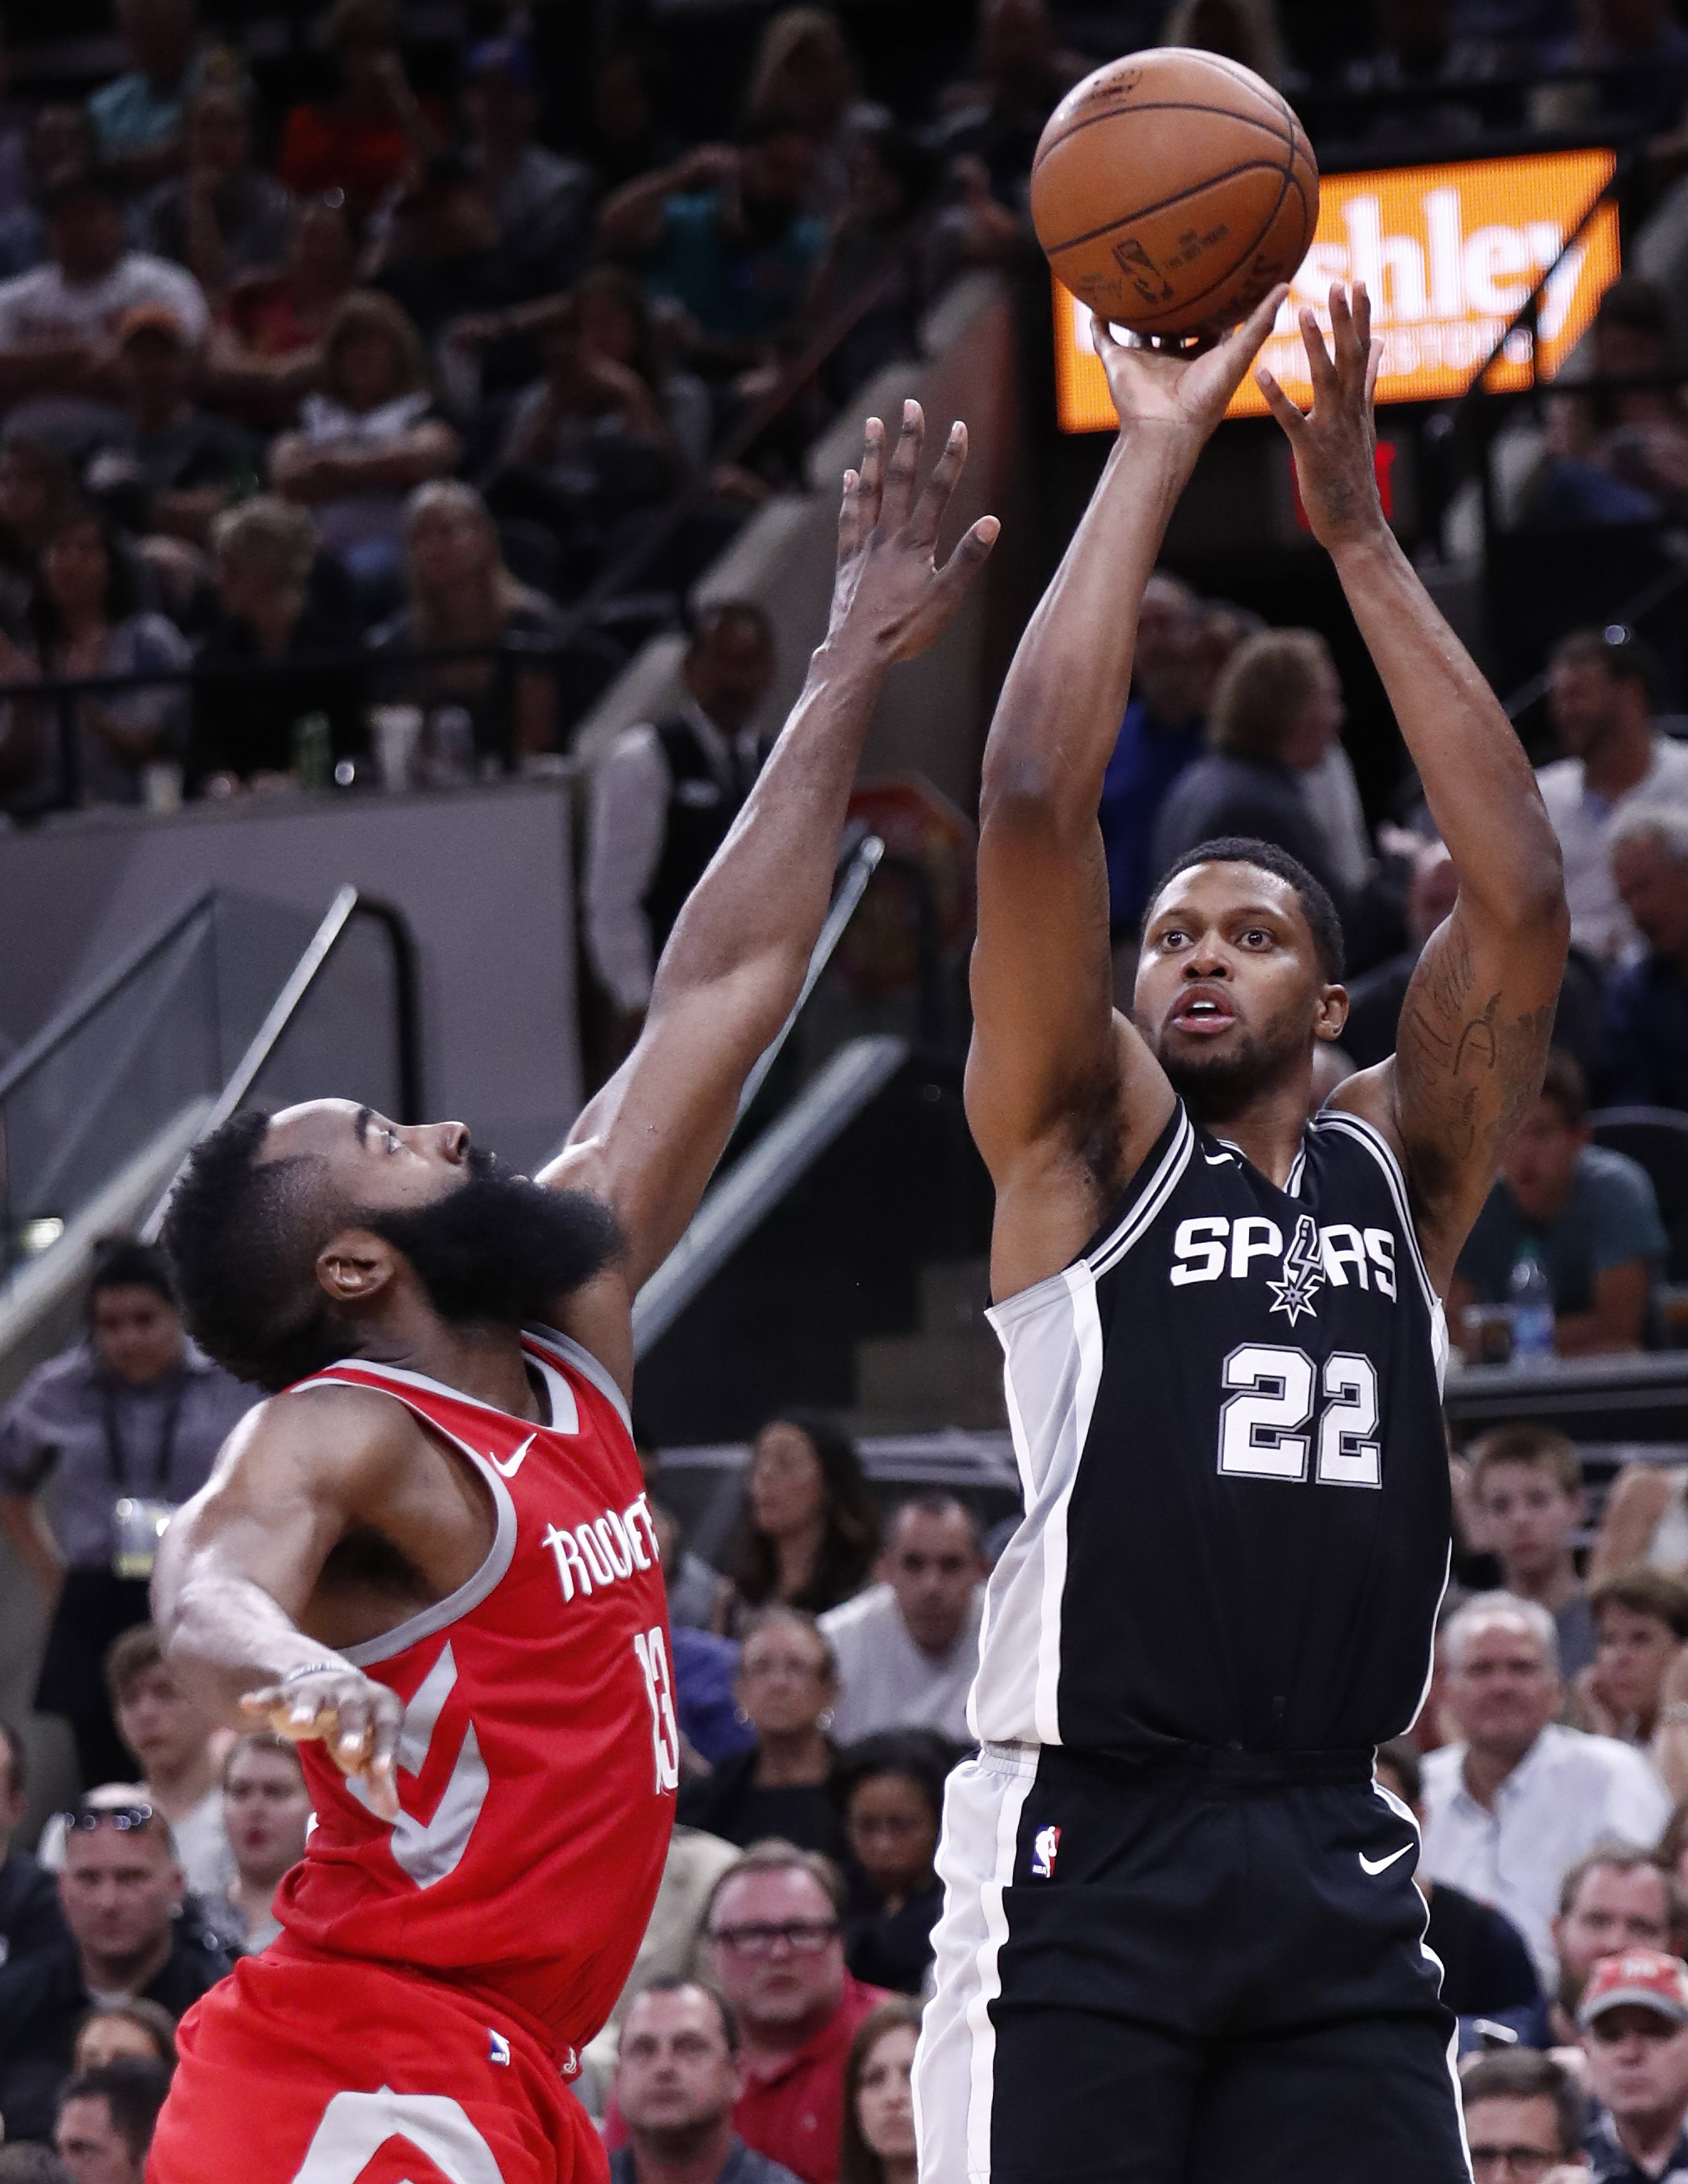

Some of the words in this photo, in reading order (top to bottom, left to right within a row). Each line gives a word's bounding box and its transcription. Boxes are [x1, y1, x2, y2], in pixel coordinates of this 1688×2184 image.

[1216, 1341, 1383, 1489] 22
[542, 1490, 660, 1602] ROCKET
[634, 1626, 679, 1795] 13
